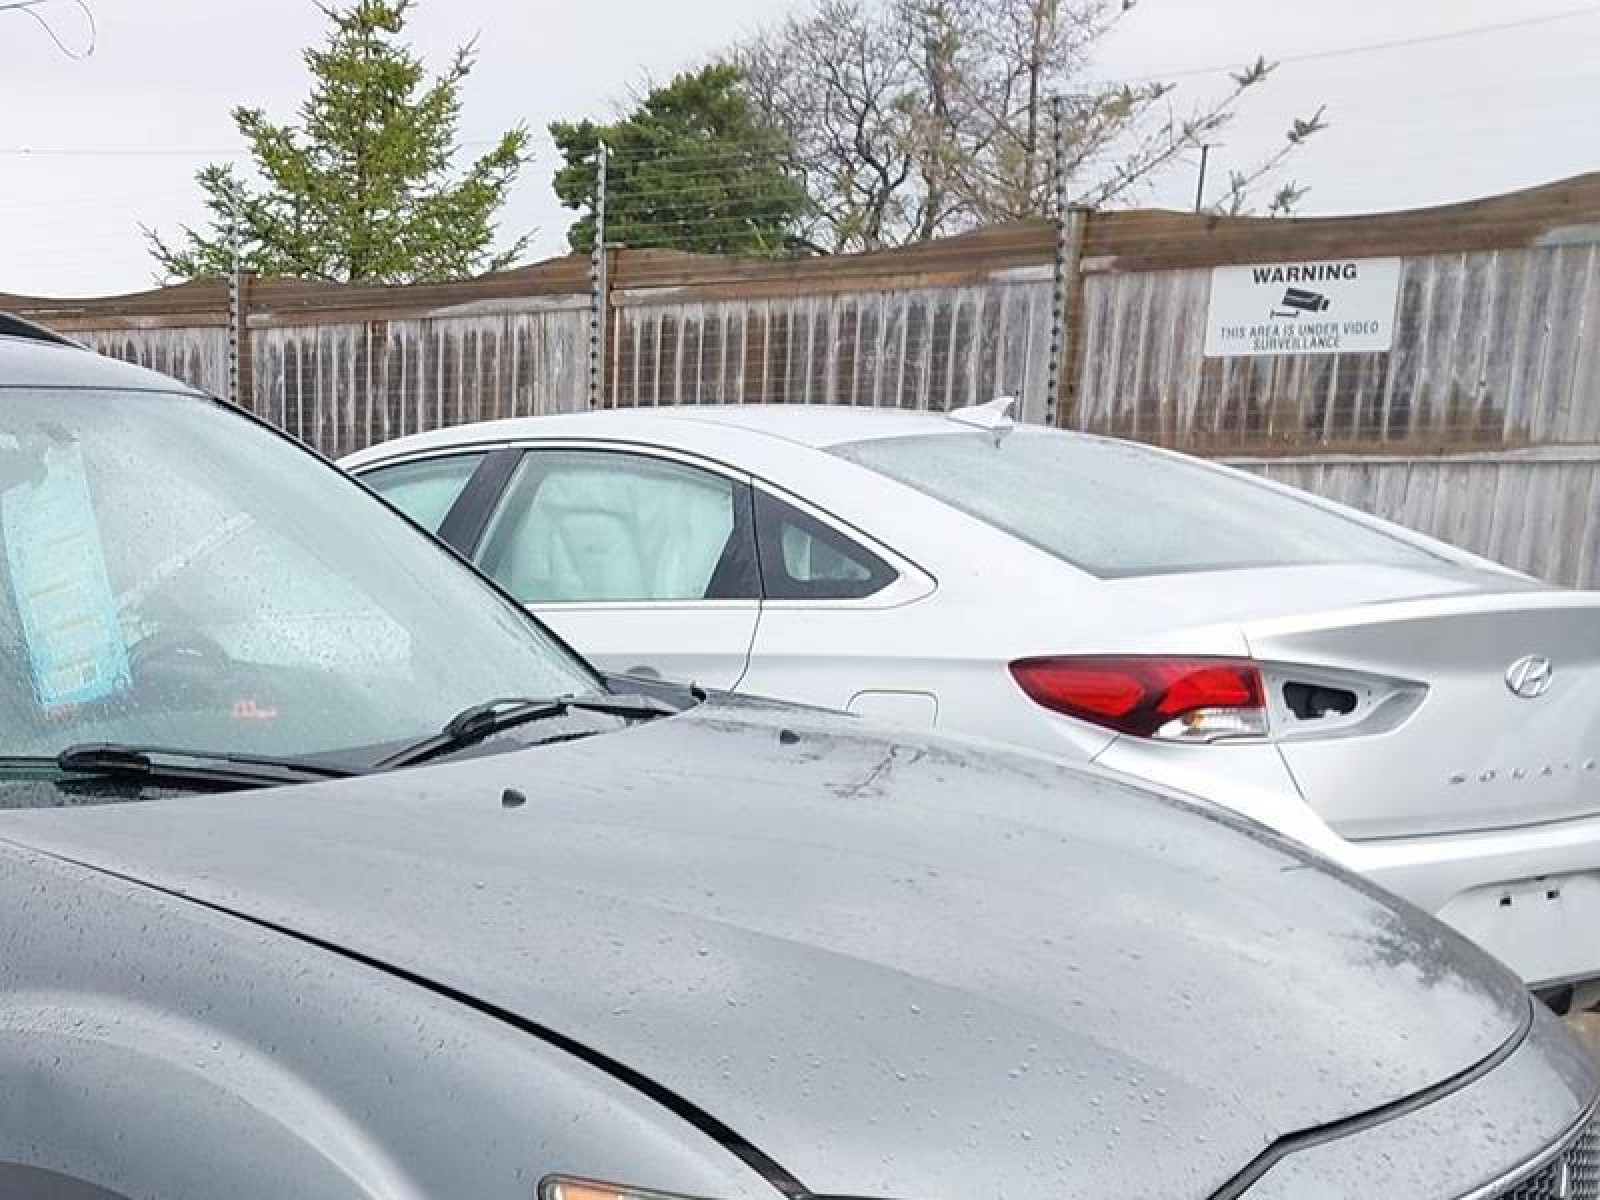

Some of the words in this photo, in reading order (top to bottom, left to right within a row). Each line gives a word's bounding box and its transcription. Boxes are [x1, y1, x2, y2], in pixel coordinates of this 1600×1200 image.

[1253, 264, 1357, 285] WARNING
[1221, 326, 1246, 339] THIS
[1250, 324, 1279, 337] AREA
[1283, 323, 1295, 336] IS
[1300, 322, 1339, 336] UNDER
[1343, 320, 1379, 334] VIDEO
